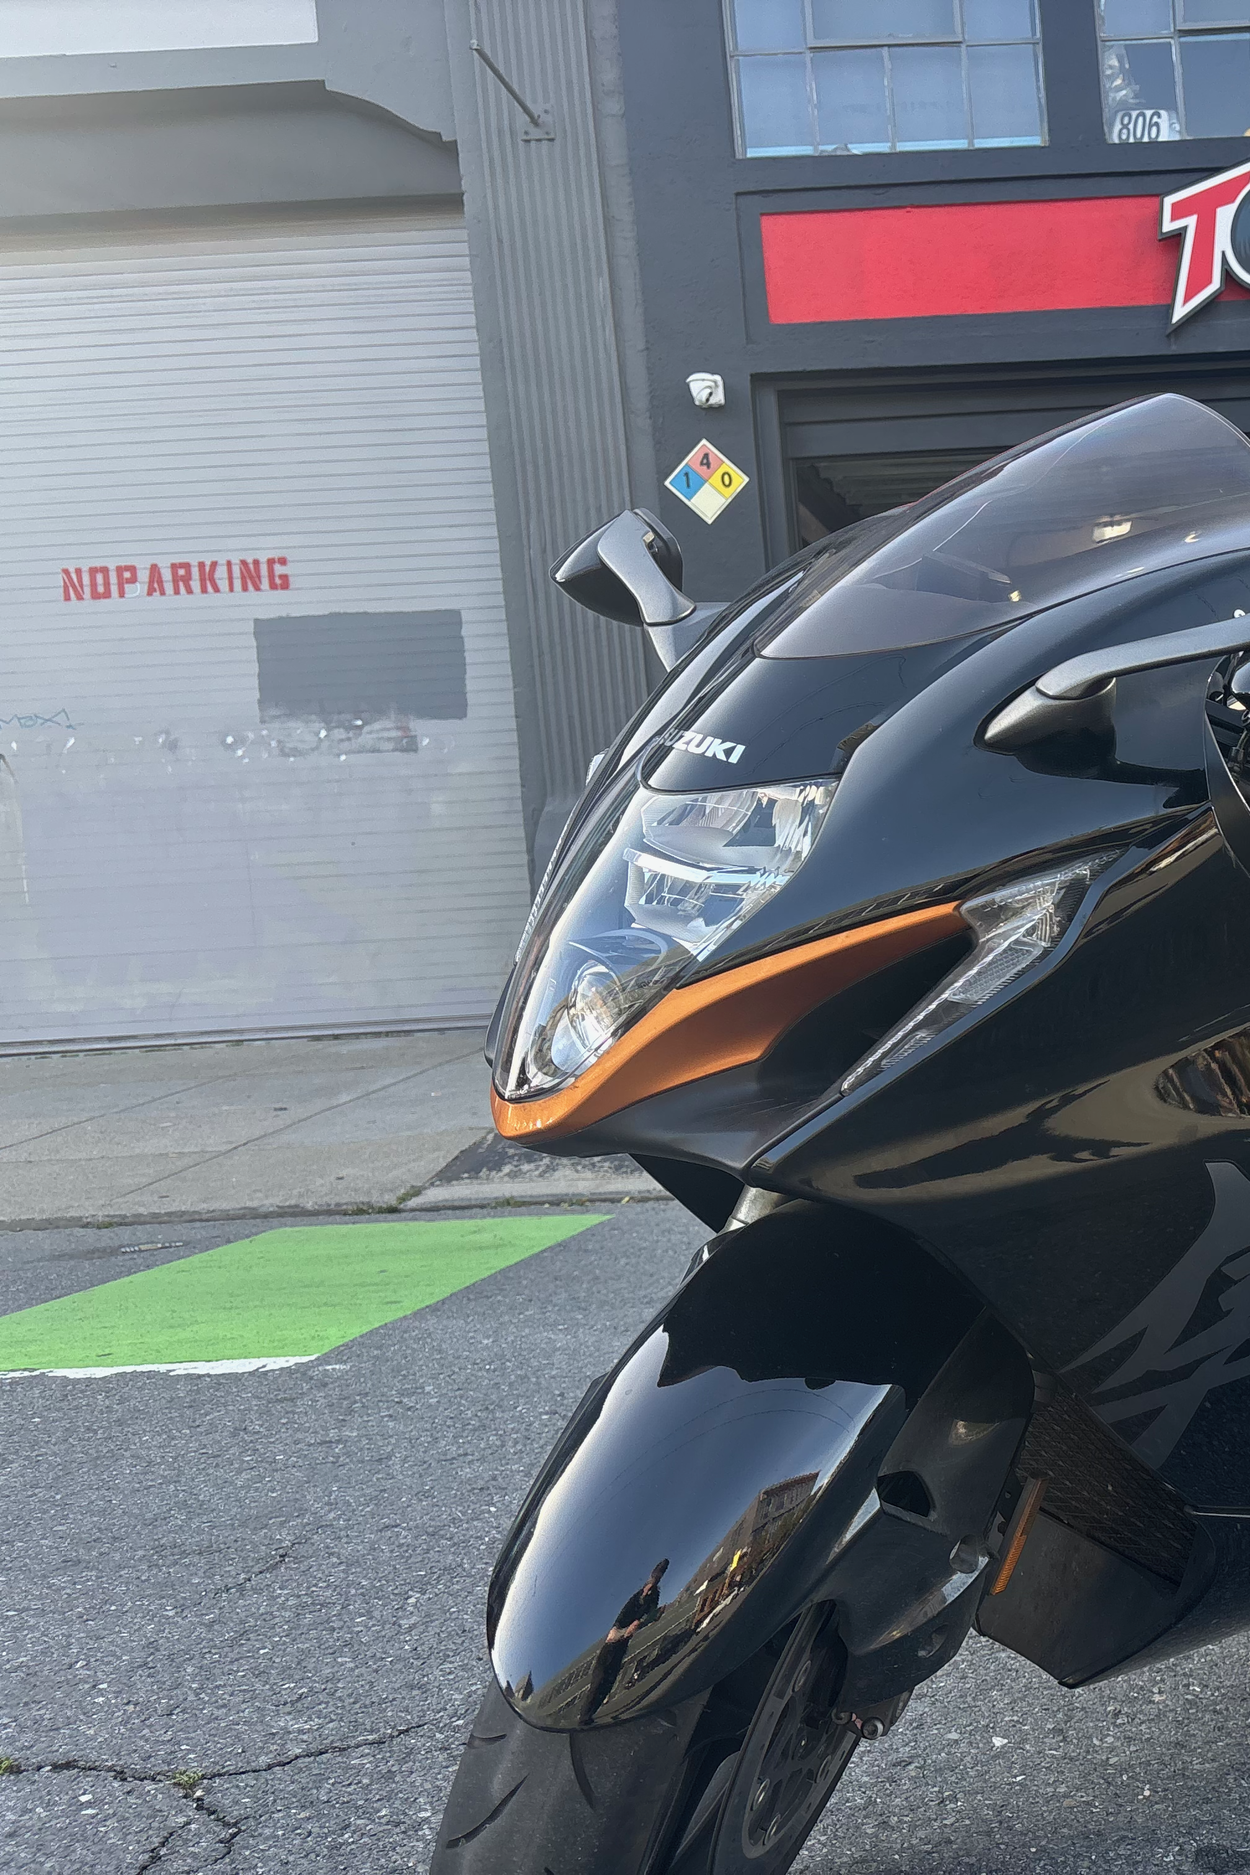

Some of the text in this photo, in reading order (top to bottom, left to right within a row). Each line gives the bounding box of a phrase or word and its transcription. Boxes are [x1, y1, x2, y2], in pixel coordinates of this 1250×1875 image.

[1119, 110, 1162, 143] 806
[699, 452, 711, 470] 4
[682, 471, 733, 489] 1 0
[660, 727, 746, 764] UZUKI
